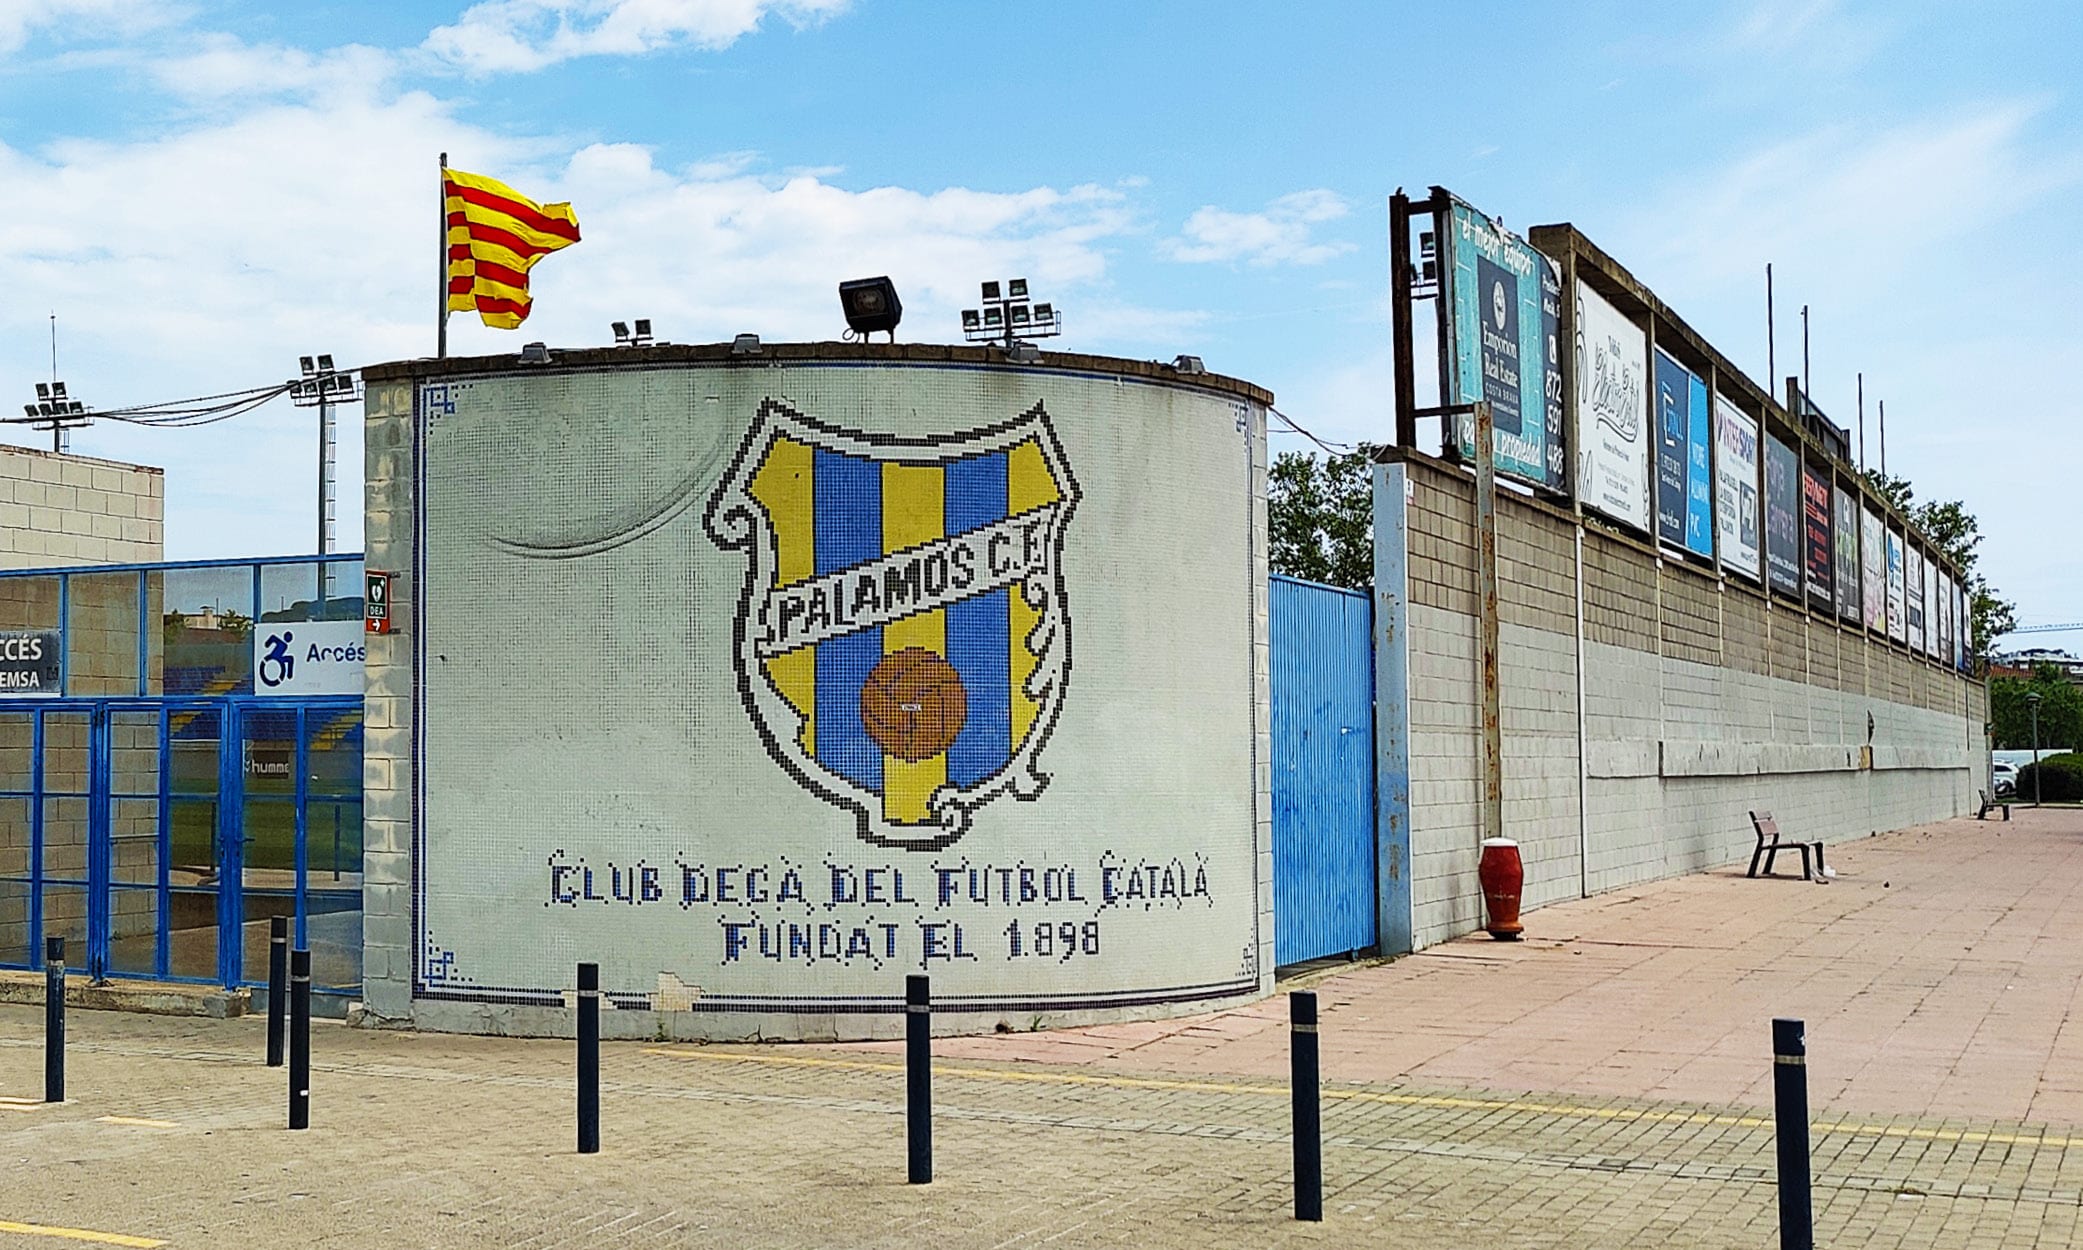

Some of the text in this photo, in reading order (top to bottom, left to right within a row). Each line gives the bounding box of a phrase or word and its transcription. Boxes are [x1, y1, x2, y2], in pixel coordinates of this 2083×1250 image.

[1482, 320, 1518, 360] Emporion
[1484, 352, 1518, 388] Real Estate
[1545, 370, 1562, 402] 872
[1547, 404, 1562, 436] 591
[1546, 443, 1564, 474] 488
[369, 605, 384, 616] DEA
[547, 855, 663, 906] CLUB
[827, 860, 917, 905] DEL
[934, 861, 1087, 906] FUTBOL
[719, 918, 900, 962] FUNDAT
[918, 919, 977, 963] EL
